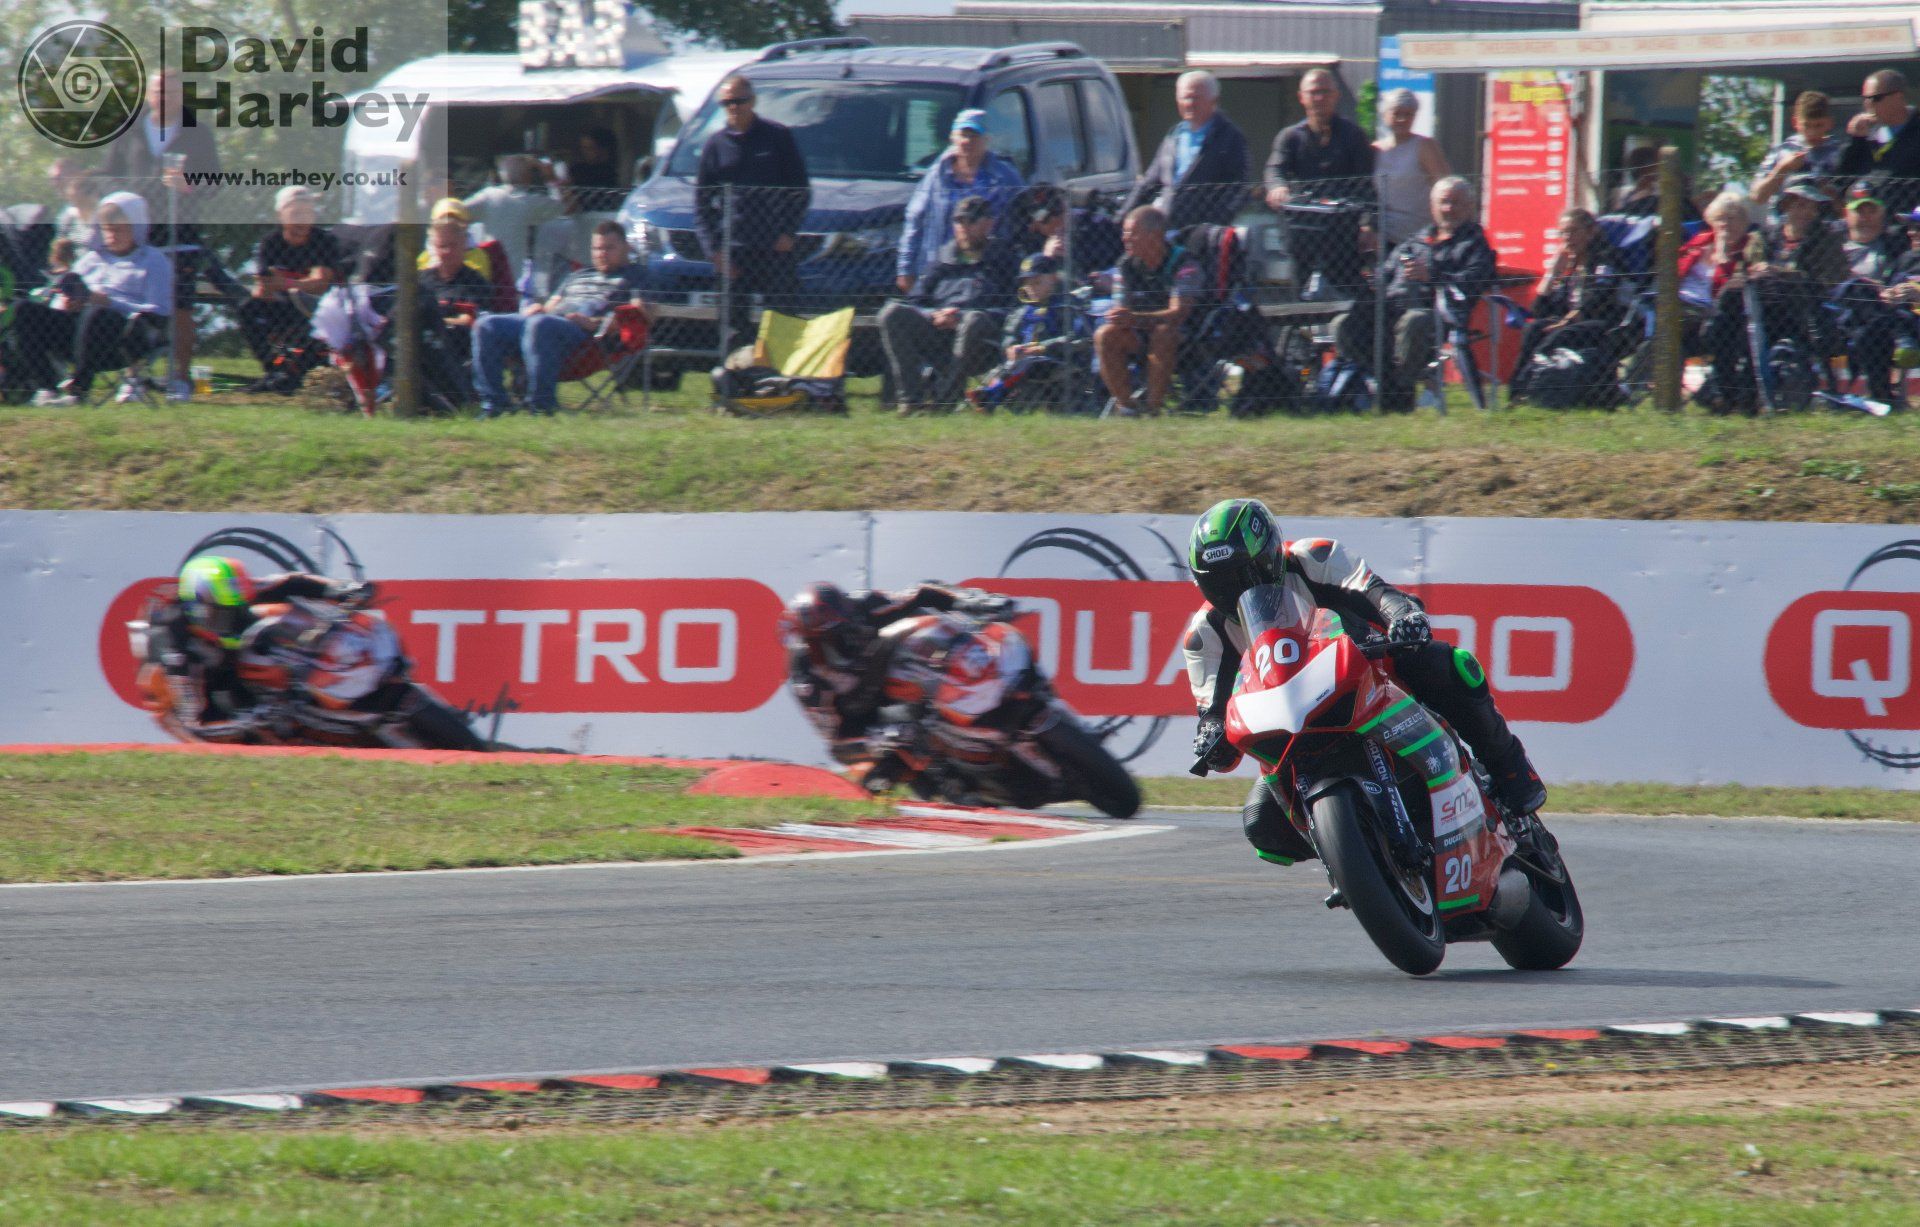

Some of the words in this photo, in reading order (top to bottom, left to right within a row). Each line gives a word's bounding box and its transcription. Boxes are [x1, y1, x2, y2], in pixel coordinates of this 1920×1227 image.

[1205, 548, 1229, 560] SHOEI
[1255, 637, 1300, 683] 20
[1366, 738, 1389, 781] MAXTON
[1445, 853, 1472, 893] 20
